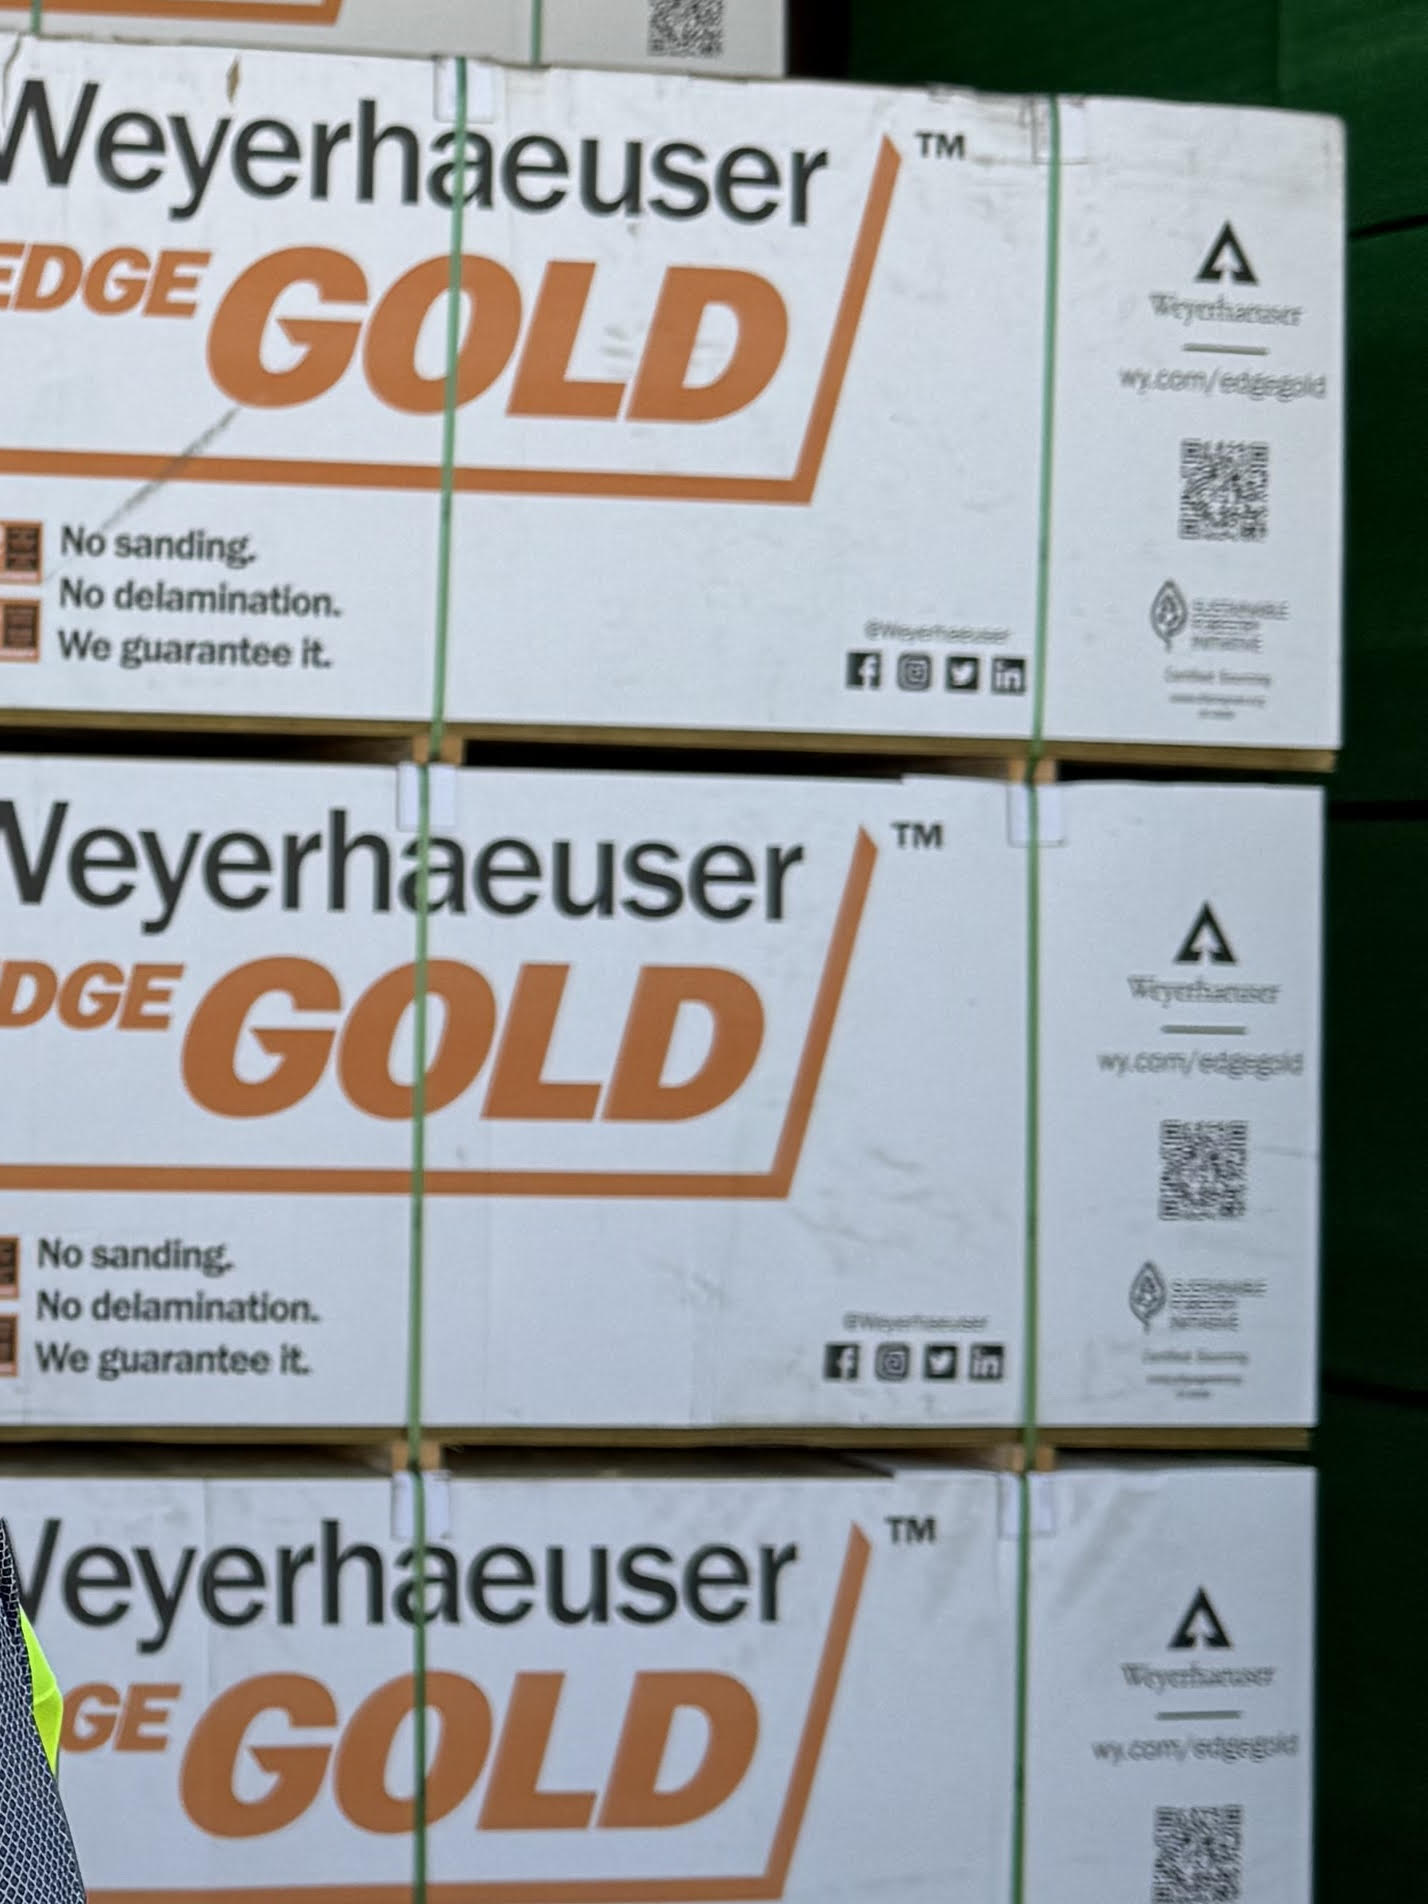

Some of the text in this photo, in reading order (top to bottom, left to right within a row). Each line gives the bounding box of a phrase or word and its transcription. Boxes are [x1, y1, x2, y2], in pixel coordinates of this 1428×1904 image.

[209, 244, 787, 424] GOLD
[61, 524, 255, 569] No sanding.
[59, 577, 340, 617] No delamination.
[57, 629, 330, 671] We guarantee it.
[182, 955, 761, 1122] GOLD
[38, 1237, 232, 1277] No sanding.
[37, 1289, 318, 1323] No delamination.
[35, 1342, 308, 1382] We guarantee it.
[58, 1670, 758, 1837] GE GOLD
